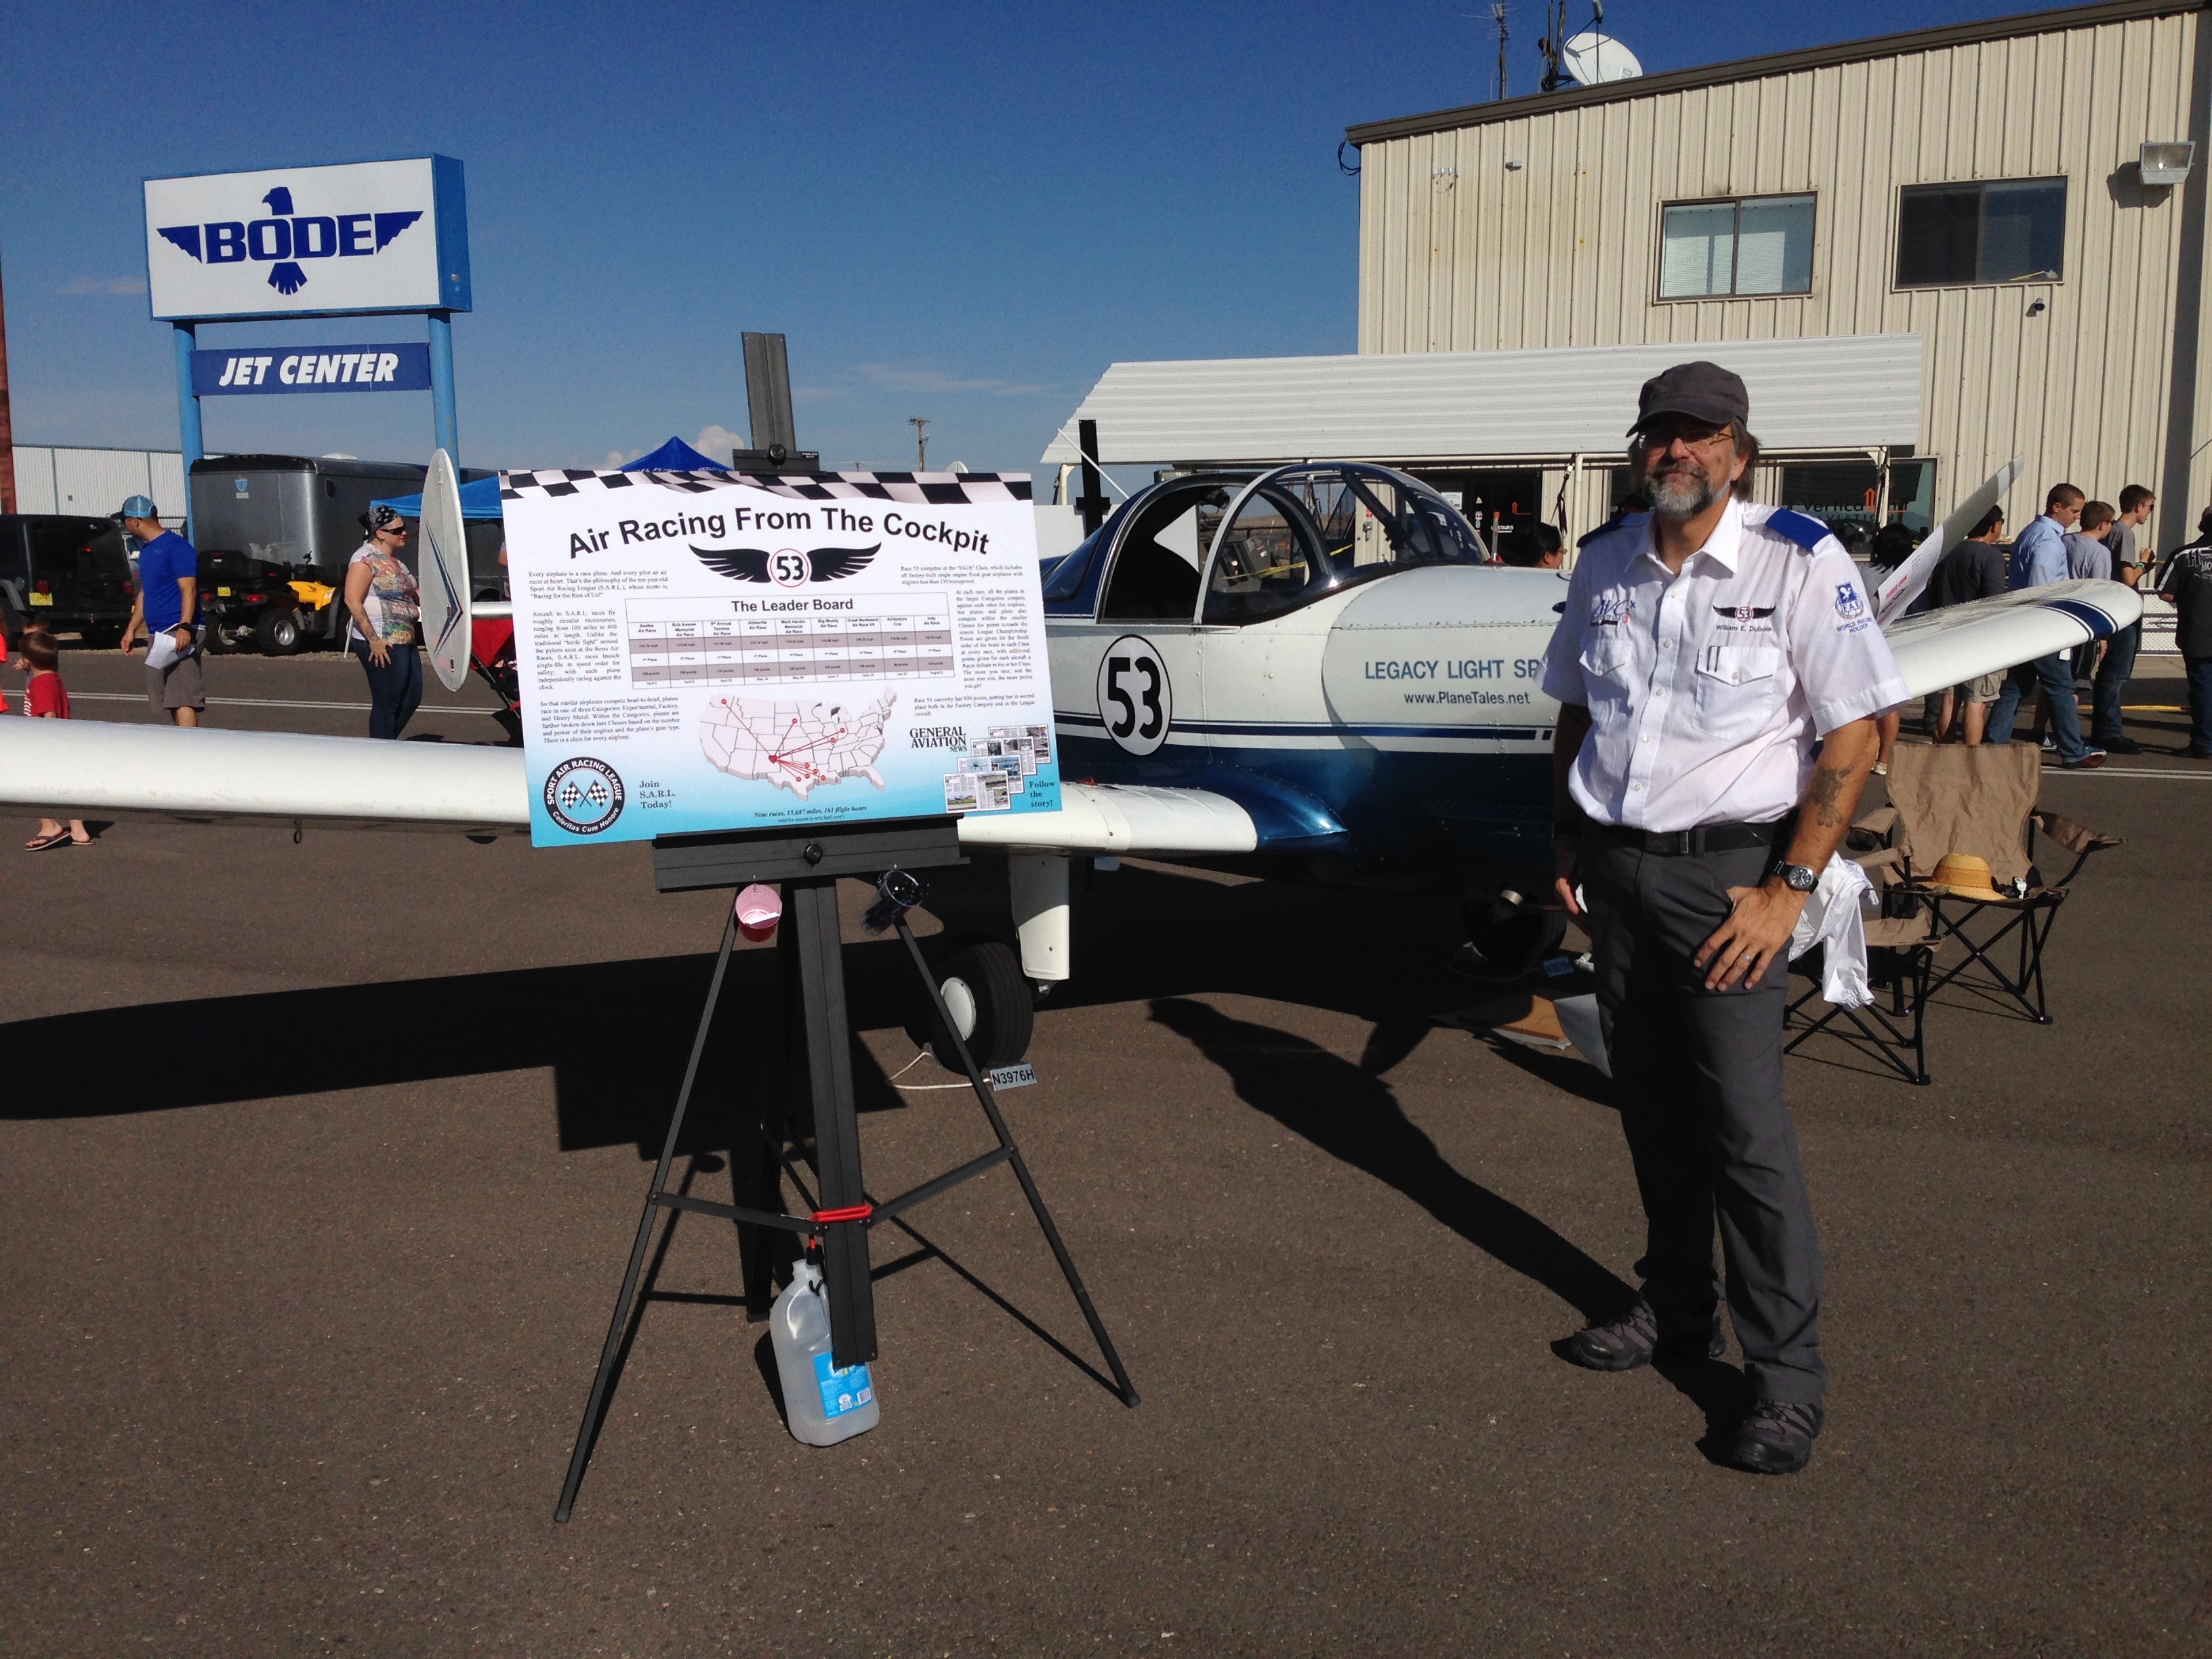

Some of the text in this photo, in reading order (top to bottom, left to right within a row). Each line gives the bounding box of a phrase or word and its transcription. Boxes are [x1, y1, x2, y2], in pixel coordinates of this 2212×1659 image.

[204, 213, 375, 264] BODE
[219, 352, 399, 387] JET CENTER
[568, 507, 989, 558] Air Racing From The Cockpit
[775, 556, 804, 581] 53
[731, 598, 854, 612] The Leader Board
[1738, 609, 1750, 619] 53
[1837, 622, 1855, 632] WORLD
[1365, 660, 1439, 679] LEGACY
[1448, 659, 1504, 679] LIGHT
[1107, 656, 1164, 740] 53
[1404, 691, 1530, 704] www.PlaneTales.net
[909, 726, 966, 738] GENERAL
[911, 736, 966, 749] AVIATION
[548, 760, 622, 805] SPORT AIR RACING LEAGUE
[640, 790, 676, 798] S.A.R.L.
[640, 800, 672, 809] Today!
[1031, 799, 1053, 807] story!
[552, 811, 579, 832] Celeritas
[992, 1069, 1035, 1085] N3976H
